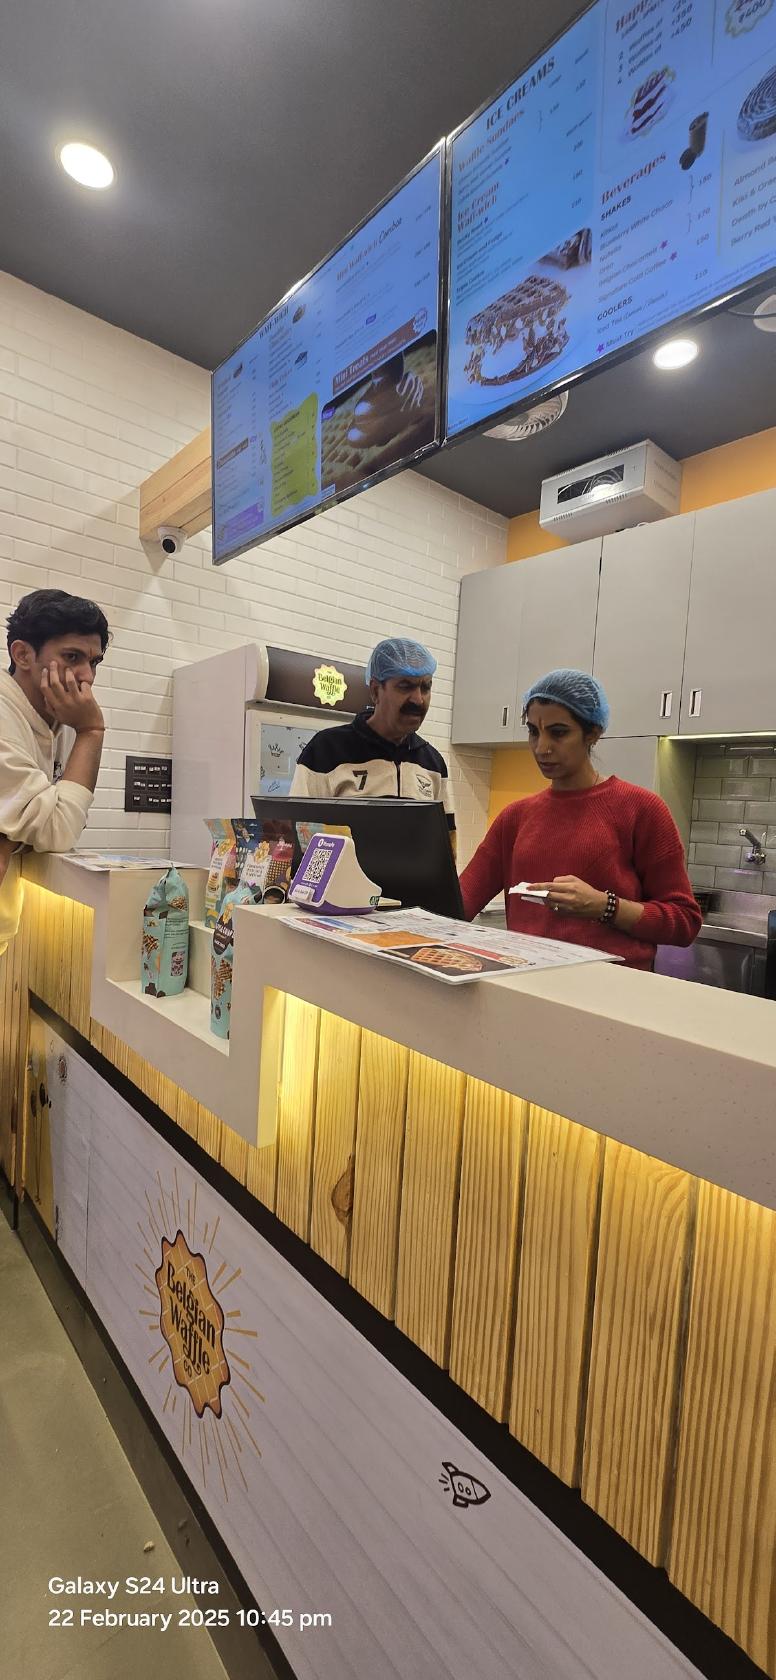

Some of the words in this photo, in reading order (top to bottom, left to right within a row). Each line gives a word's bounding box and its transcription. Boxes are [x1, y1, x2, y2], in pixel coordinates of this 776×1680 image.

[486, 105, 502, 130] ICE
[506, 56, 555, 111] CREAMS
[602, 152, 666, 205] Beverages
[600, 195, 631, 221] SHAKES
[597, 296, 633, 320] COOLERS
[317, 673, 342, 686] Belgian
[320, 683, 340, 696] Waffle
[352, 769, 369, 791] 7
[185, 1265, 196, 1286] THE
[167, 1260, 216, 1349] Belgian
[170, 1296, 210, 1376] Waffle
